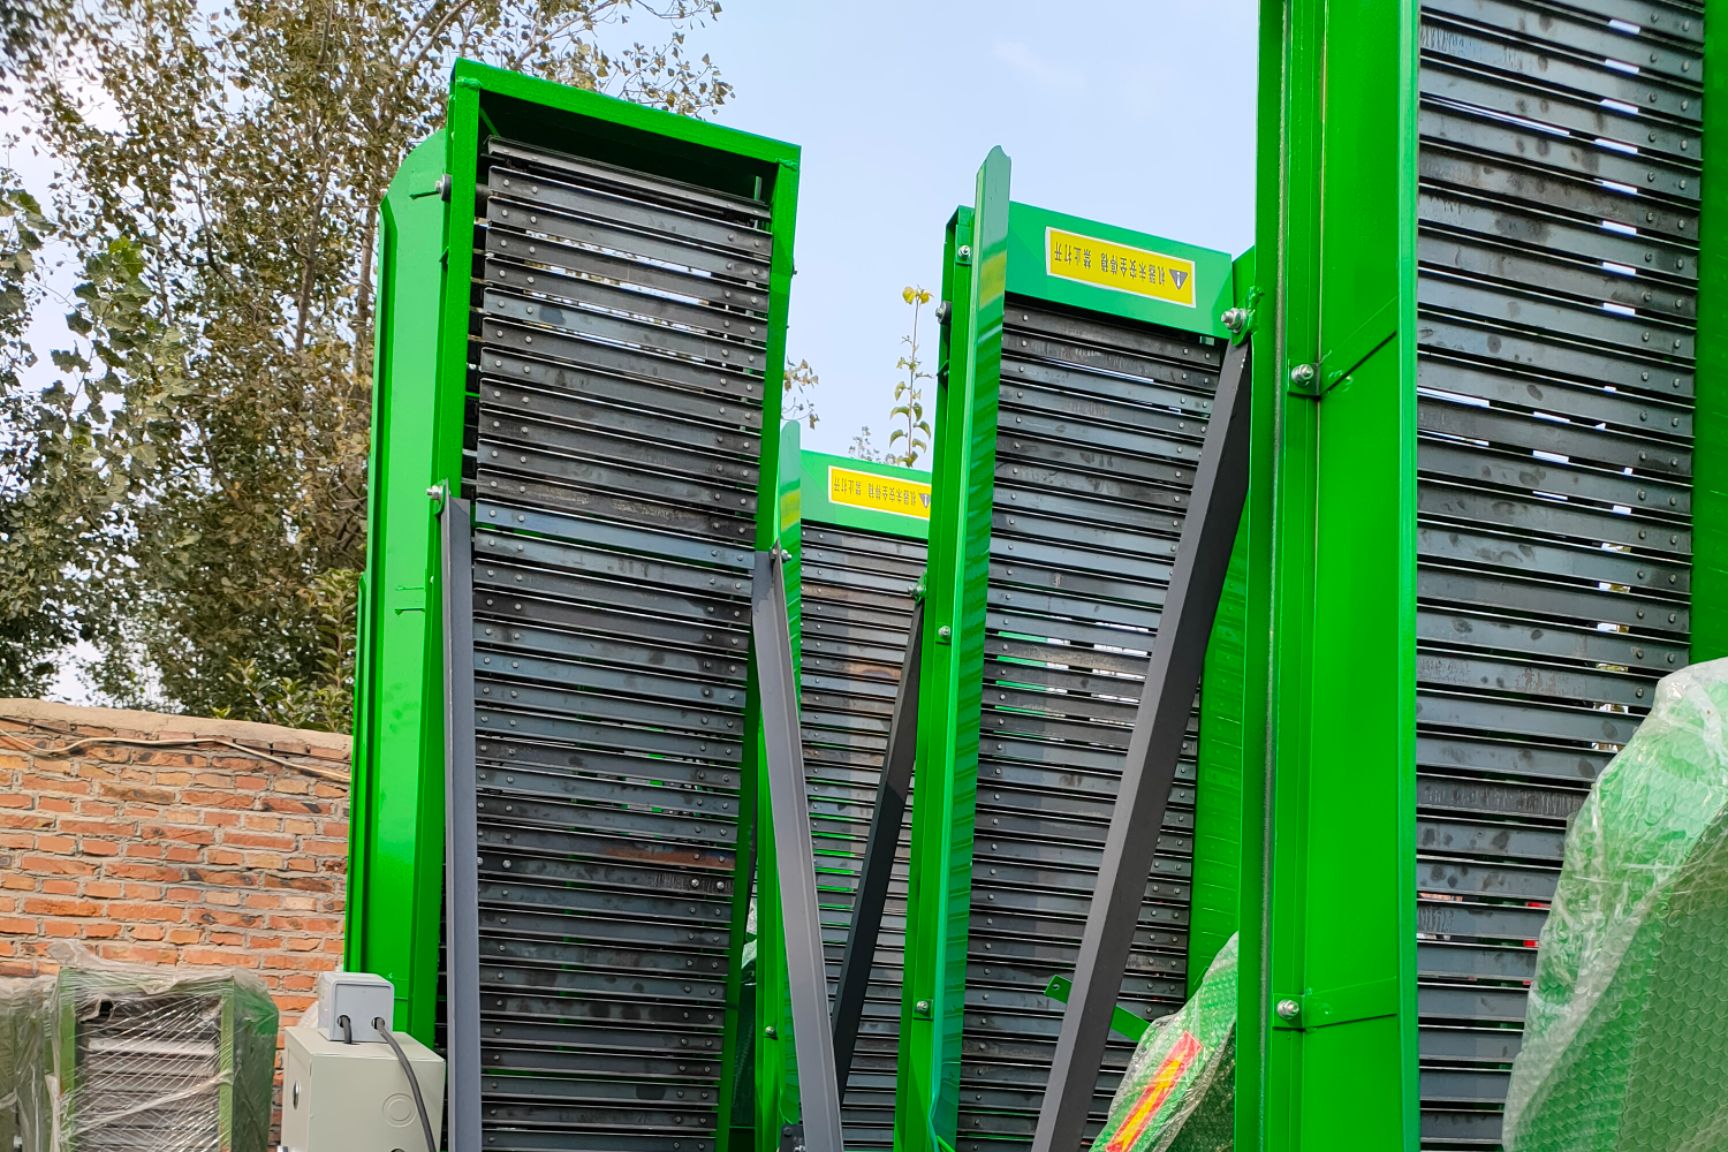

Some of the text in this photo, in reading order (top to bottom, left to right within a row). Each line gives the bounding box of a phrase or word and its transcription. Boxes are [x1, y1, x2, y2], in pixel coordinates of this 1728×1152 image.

[1054, 241, 1165, 286] 机器未安全停稳 禁止打开
